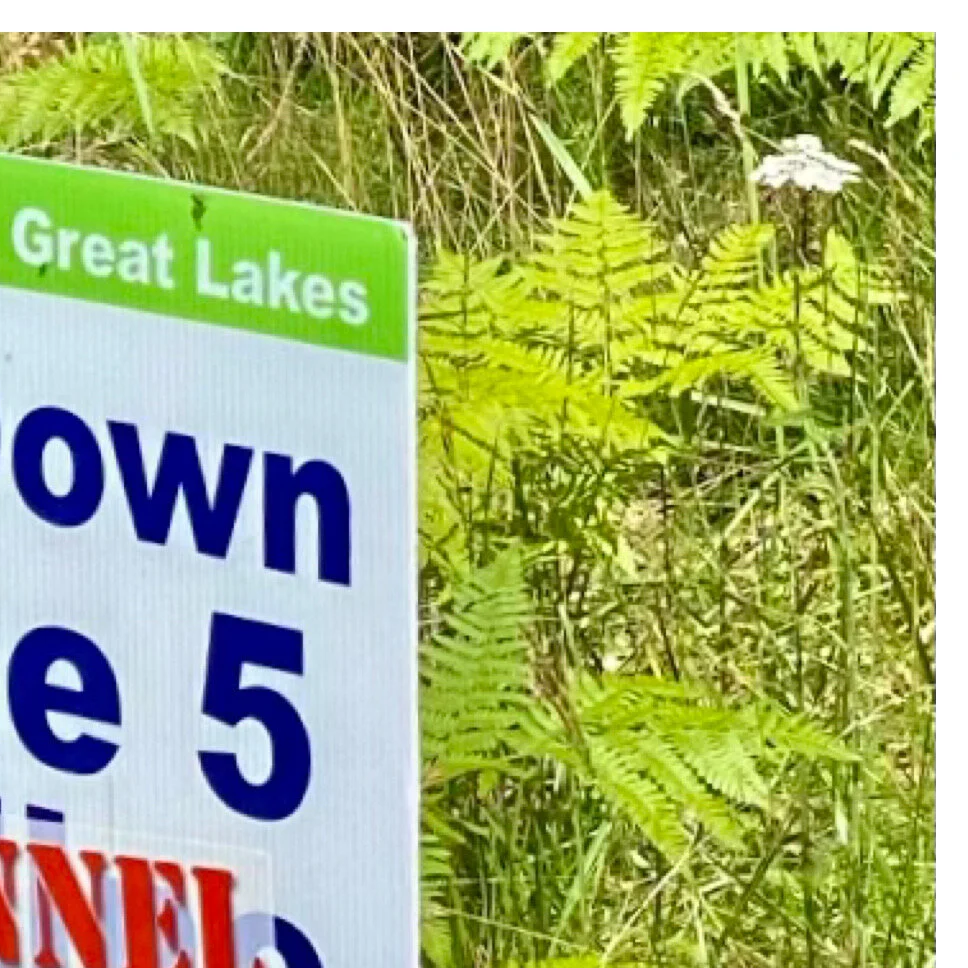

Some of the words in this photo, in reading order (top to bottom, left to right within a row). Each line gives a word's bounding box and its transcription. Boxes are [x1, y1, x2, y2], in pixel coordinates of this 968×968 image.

[11, 206, 175, 290] Great
[195, 237, 370, 325] Lakes
[198, 611, 312, 823] 5
